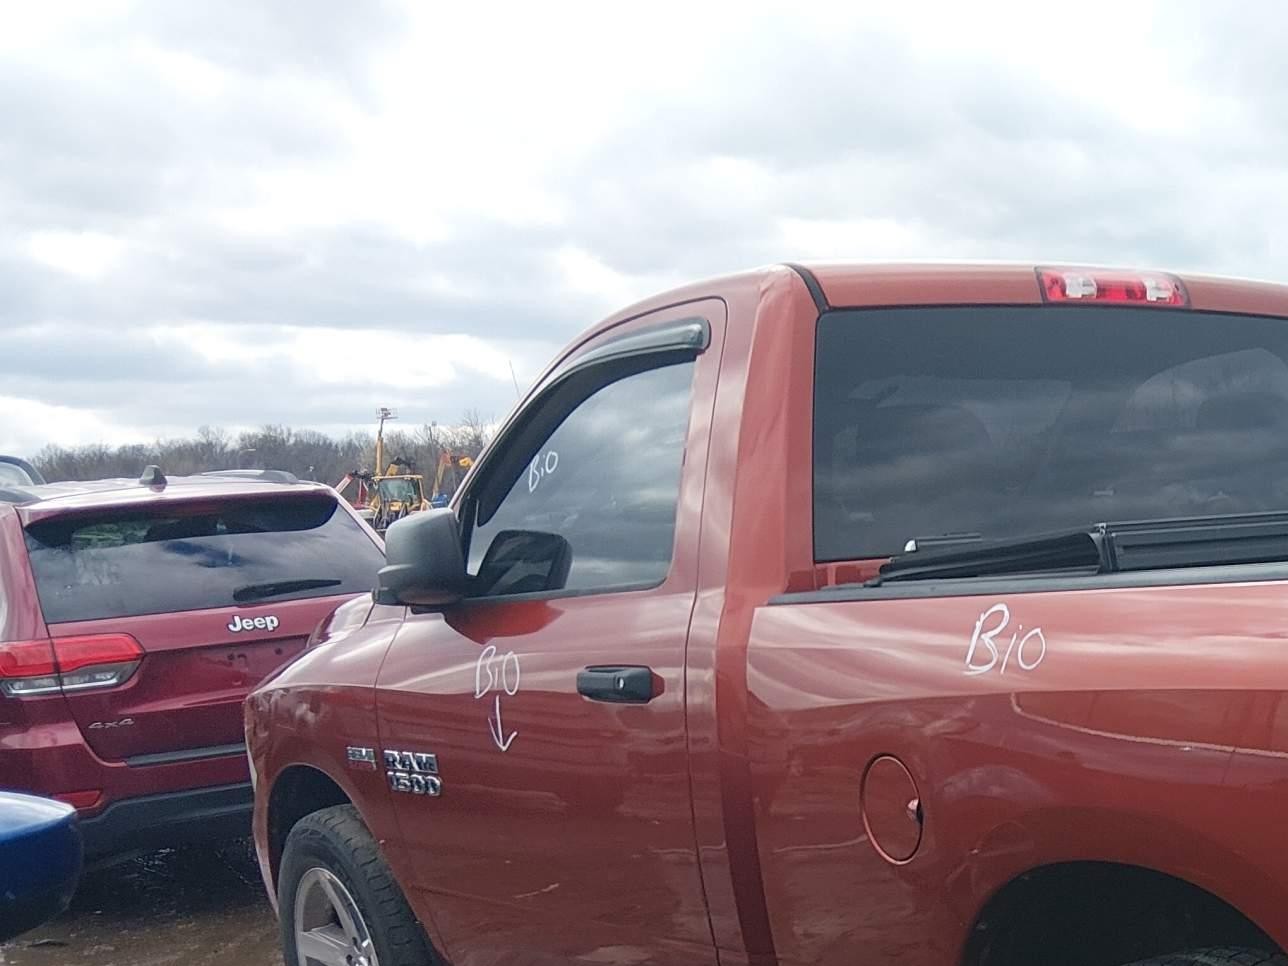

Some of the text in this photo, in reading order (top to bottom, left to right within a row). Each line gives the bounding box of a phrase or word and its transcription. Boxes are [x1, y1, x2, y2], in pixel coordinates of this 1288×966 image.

[226, 614, 280, 632] Jeep
[383, 749, 439, 773] RAM
[386, 771, 442, 796] 1500
